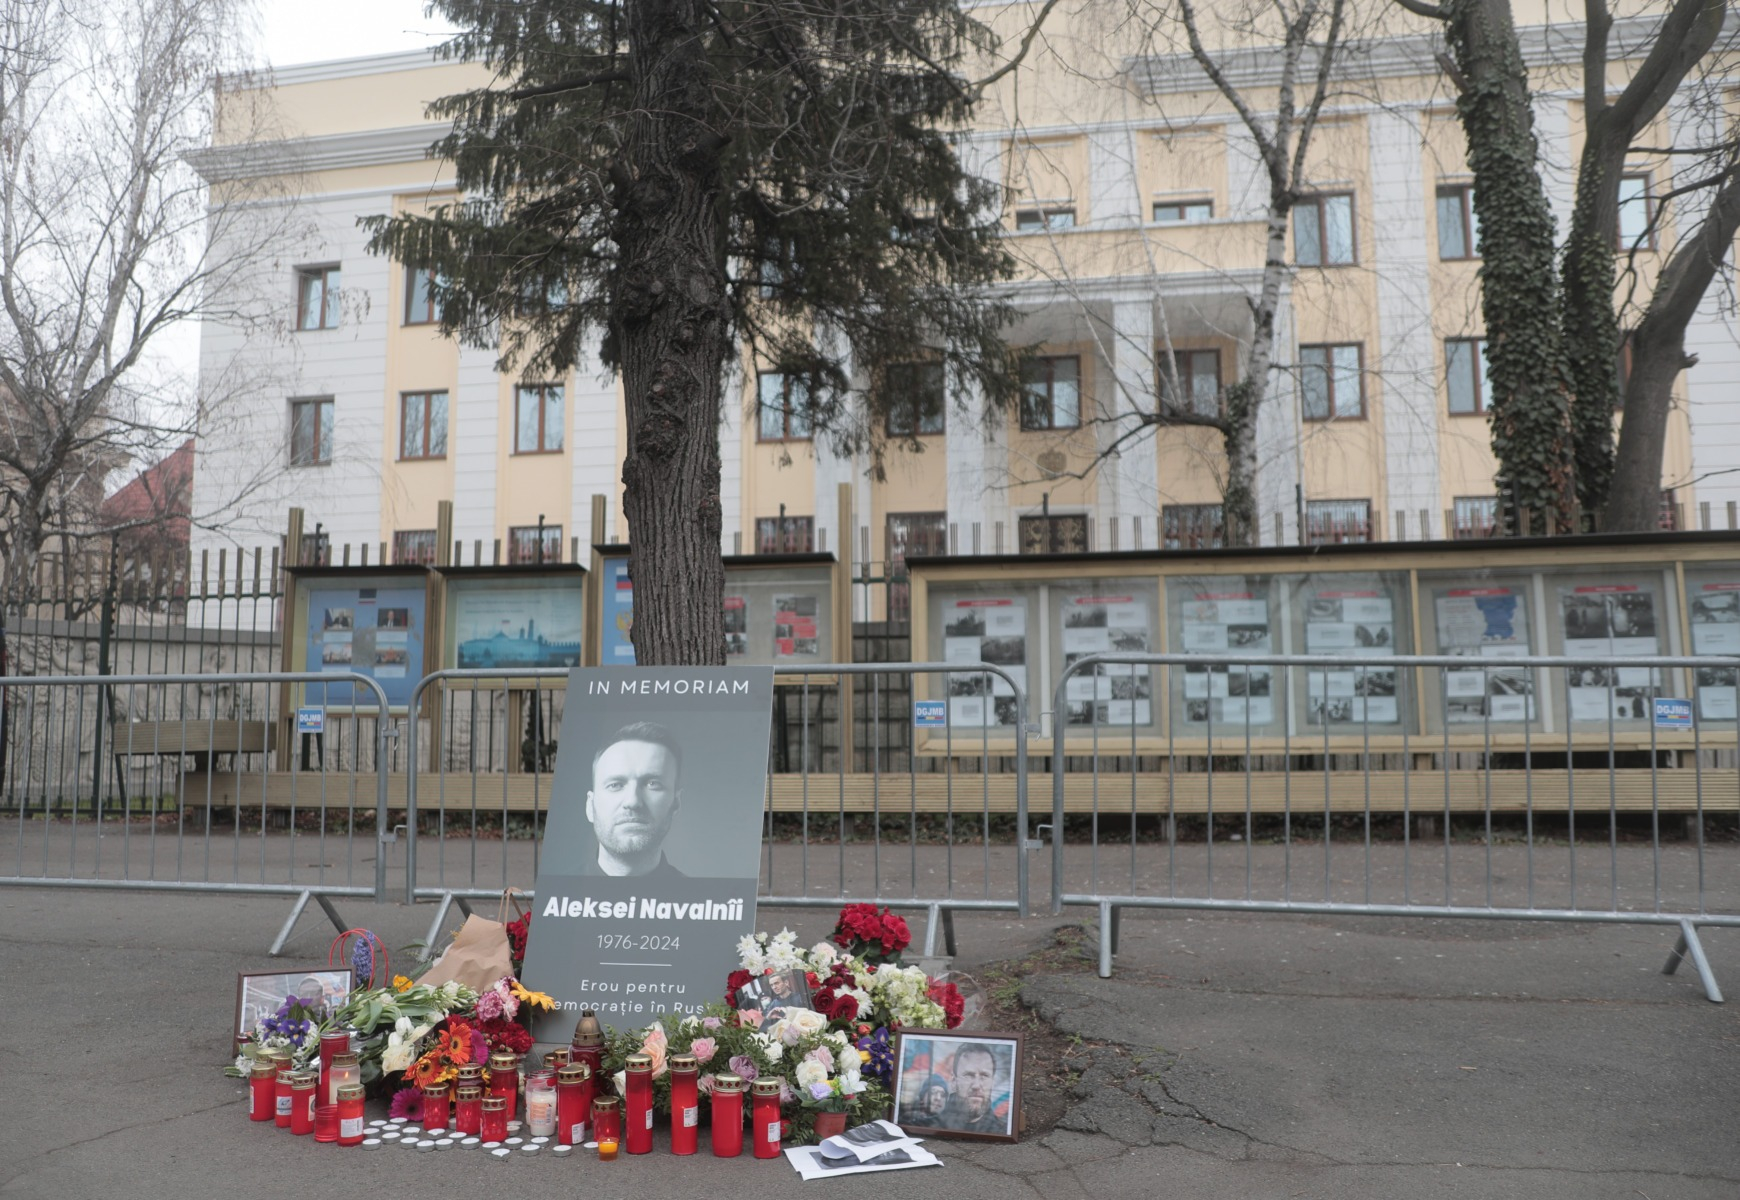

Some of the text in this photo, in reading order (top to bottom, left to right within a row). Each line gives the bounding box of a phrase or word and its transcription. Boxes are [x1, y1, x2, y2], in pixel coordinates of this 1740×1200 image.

[588, 679, 750, 695] IN MEMORIAM
[916, 707, 944, 716] DGJMB
[1656, 704, 1690, 715] DGJMB
[543, 896, 744, 921] Aleksei Navalnîi
[597, 934, 681, 951] 1976-2024
[580, 979, 686, 995] Erou pentru
[547, 1000, 643, 1016] emocrație
[650, 1001, 666, 1014] în
